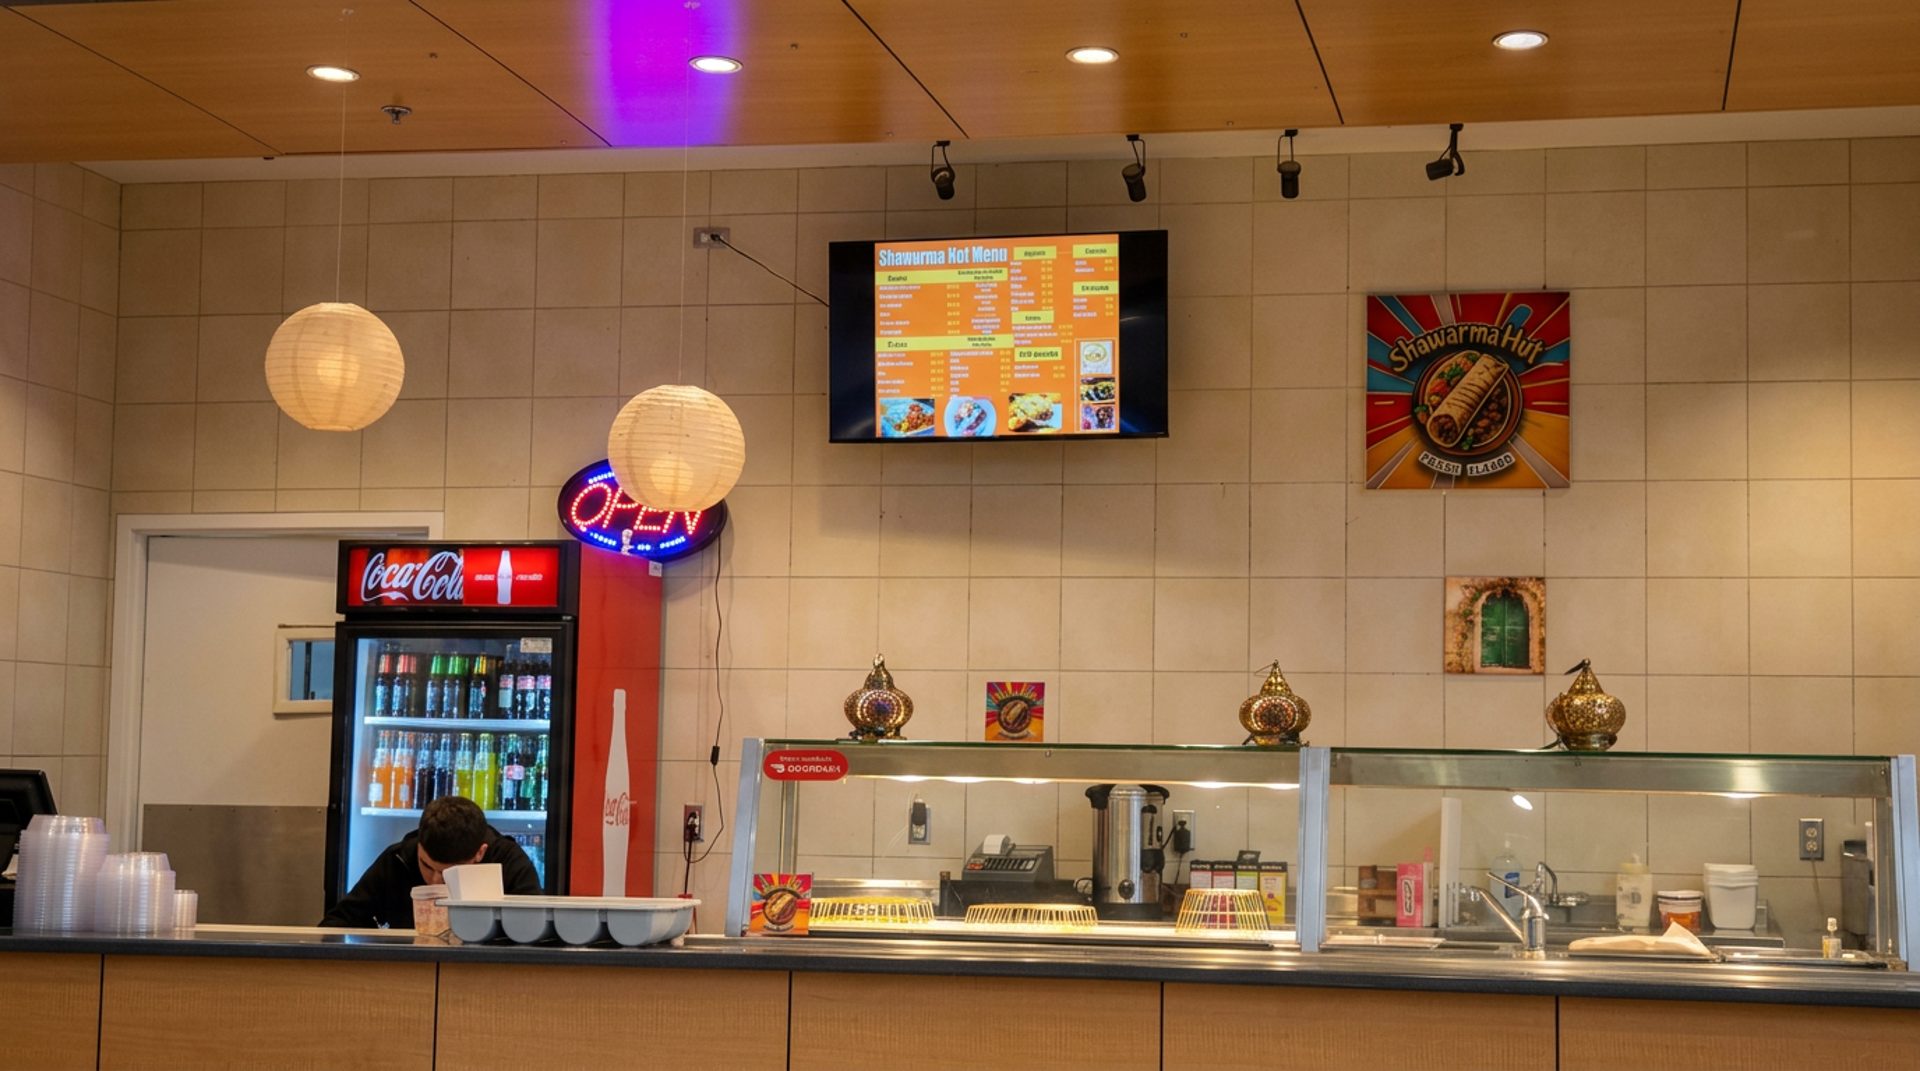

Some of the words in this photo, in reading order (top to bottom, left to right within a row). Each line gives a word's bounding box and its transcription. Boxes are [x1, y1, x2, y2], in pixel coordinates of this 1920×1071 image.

[972, 245, 1008, 263] Menu
[1389, 325, 1500, 372] Shawarma
[1501, 323, 1544, 365] Hut
[570, 481, 702, 534] OPEN
